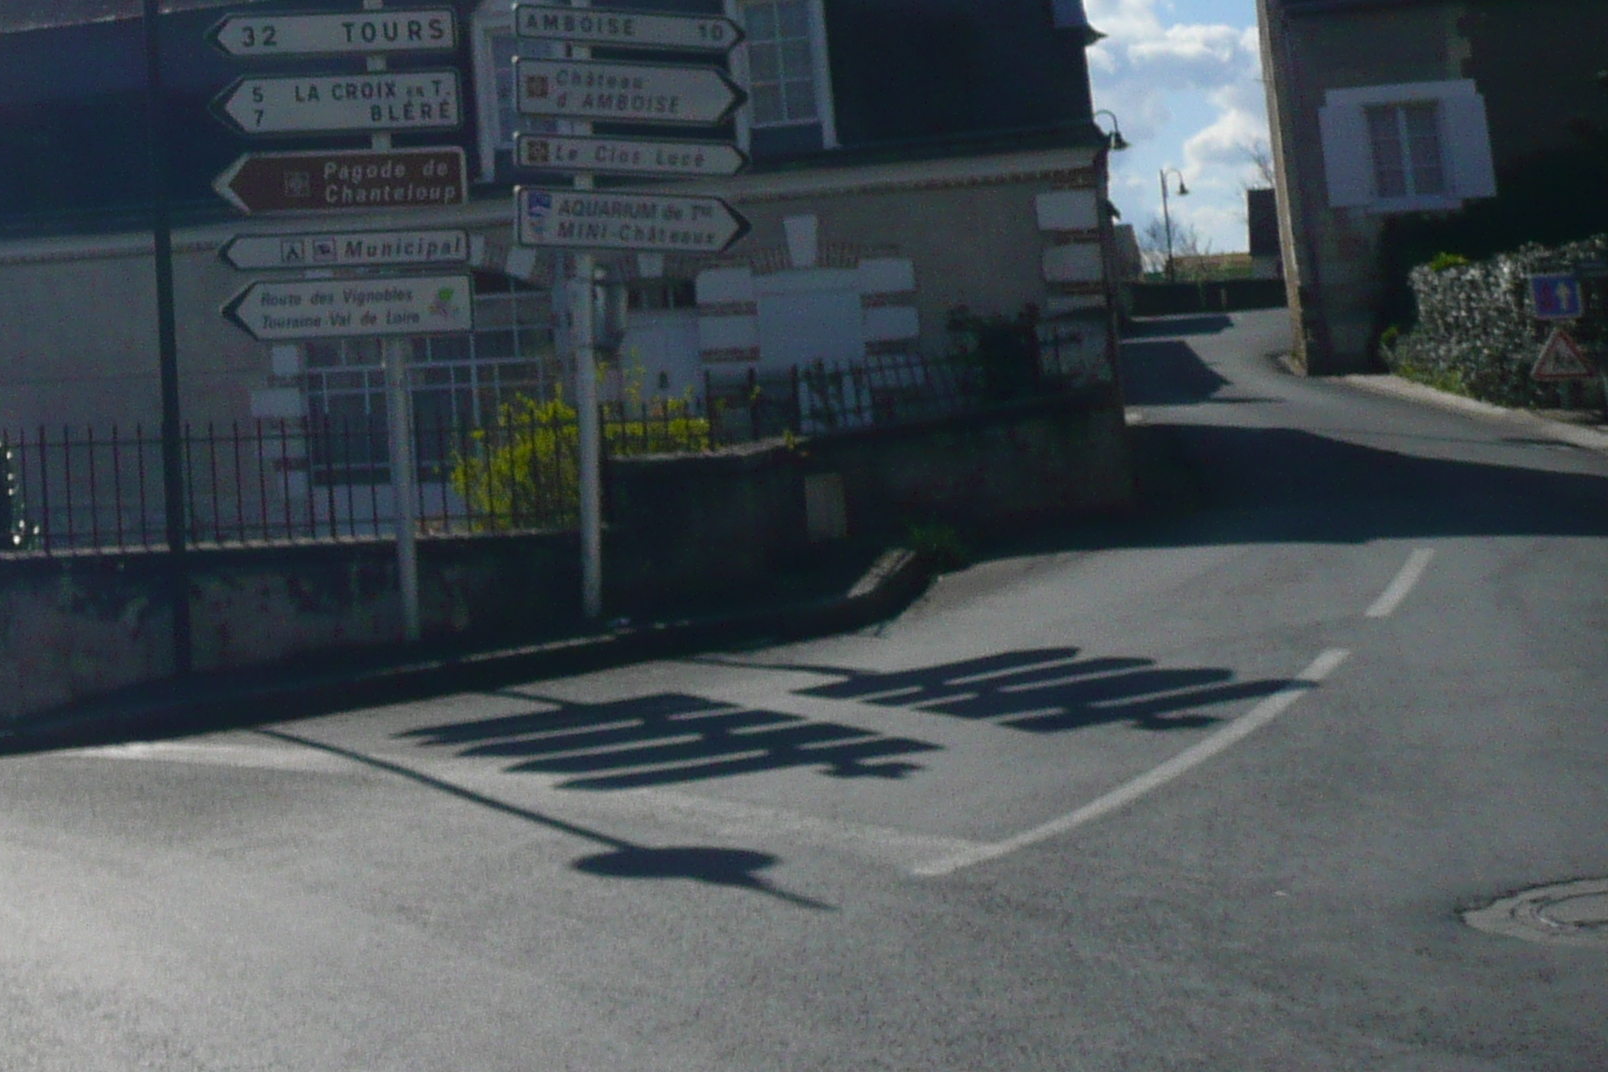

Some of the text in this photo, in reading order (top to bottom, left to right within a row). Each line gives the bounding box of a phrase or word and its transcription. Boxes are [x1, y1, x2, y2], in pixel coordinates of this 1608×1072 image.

[241, 18, 445, 47] 32 TOURS
[527, 13, 724, 41] AMBOISE 10
[555, 69, 643, 90] Château
[252, 85, 264, 103] 5
[294, 84, 320, 102] LA
[331, 81, 396, 101] CROIX
[253, 99, 451, 127] 7 BLÉRÉ
[555, 143, 705, 166] Le Clos Lucé
[323, 158, 448, 185] Pagode de
[324, 182, 457, 204] Chanteloup
[558, 199, 657, 220] AQUARIUM
[661, 203, 683, 221] de
[343, 236, 462, 259] Municipal
[260, 285, 413, 306] Route des Vignobles
[359, 311, 378, 326] de
[385, 309, 420, 325] Loire
